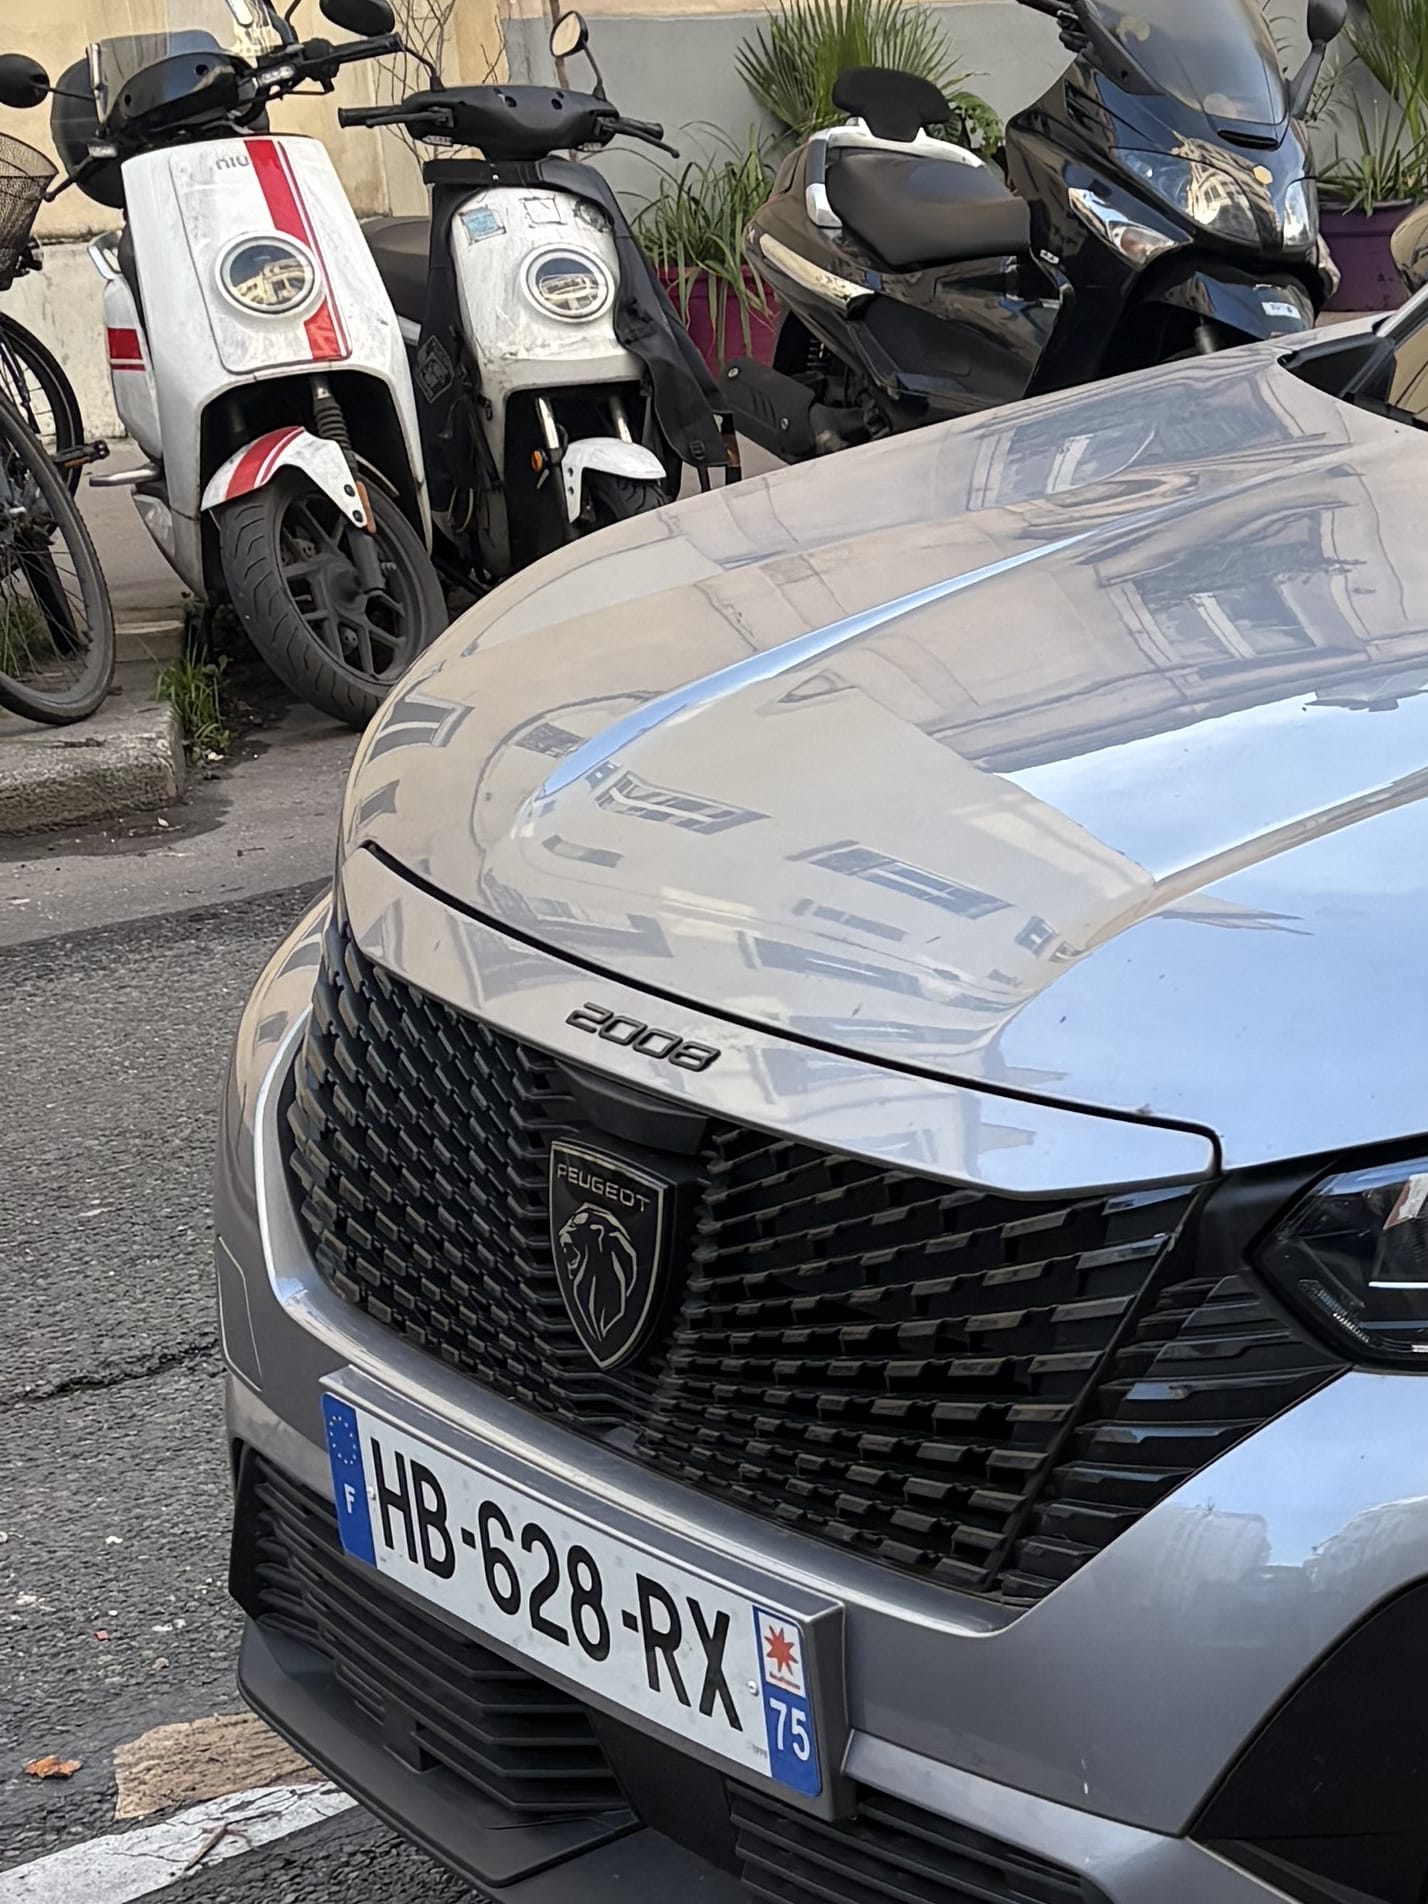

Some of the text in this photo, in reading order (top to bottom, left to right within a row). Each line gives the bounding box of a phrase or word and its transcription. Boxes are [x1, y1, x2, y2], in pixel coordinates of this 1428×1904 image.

[565, 1002, 721, 1072] 2008
[556, 1163, 650, 1213] PEUGEOT
[343, 1484, 356, 1514] F
[369, 1437, 743, 1733] HB-628-RX
[769, 1698, 810, 1762] 75
